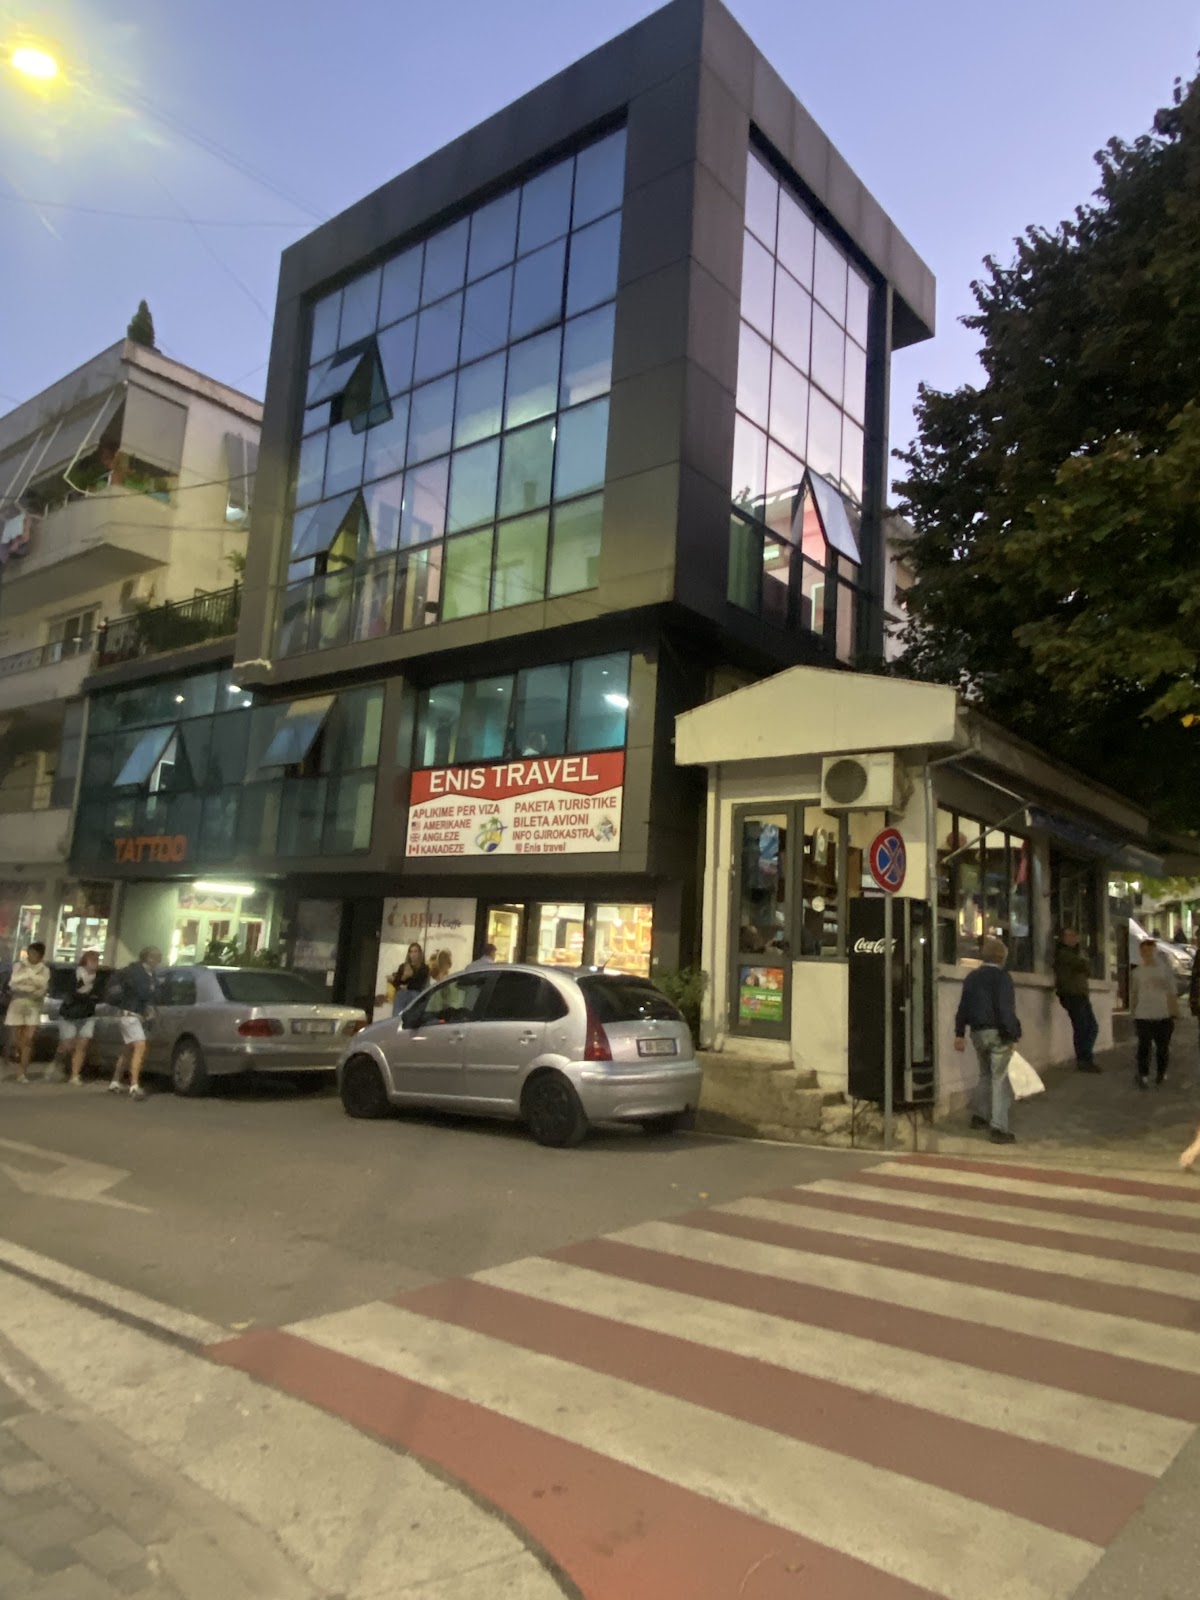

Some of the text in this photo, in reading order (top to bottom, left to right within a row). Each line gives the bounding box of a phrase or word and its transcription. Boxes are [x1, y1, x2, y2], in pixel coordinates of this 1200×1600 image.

[429, 757, 599, 793] ENIS TRAVEL
[412, 804, 500, 819] APLIKIME PER VIZA
[514, 796, 617, 813] PAKETA TURISTIKE
[423, 819, 472, 831] AMERIKANE
[513, 814, 589, 828] BILETA AVIONI
[422, 831, 460, 842] ANGLEZE
[512, 828, 595, 841] INFO GJIROKASTRA
[115, 834, 187, 864] TATTOO
[421, 843, 465, 855] KANADEZE
[524, 842, 566, 853] Enis travel
[854, 937, 897, 954] Coca-Coa
